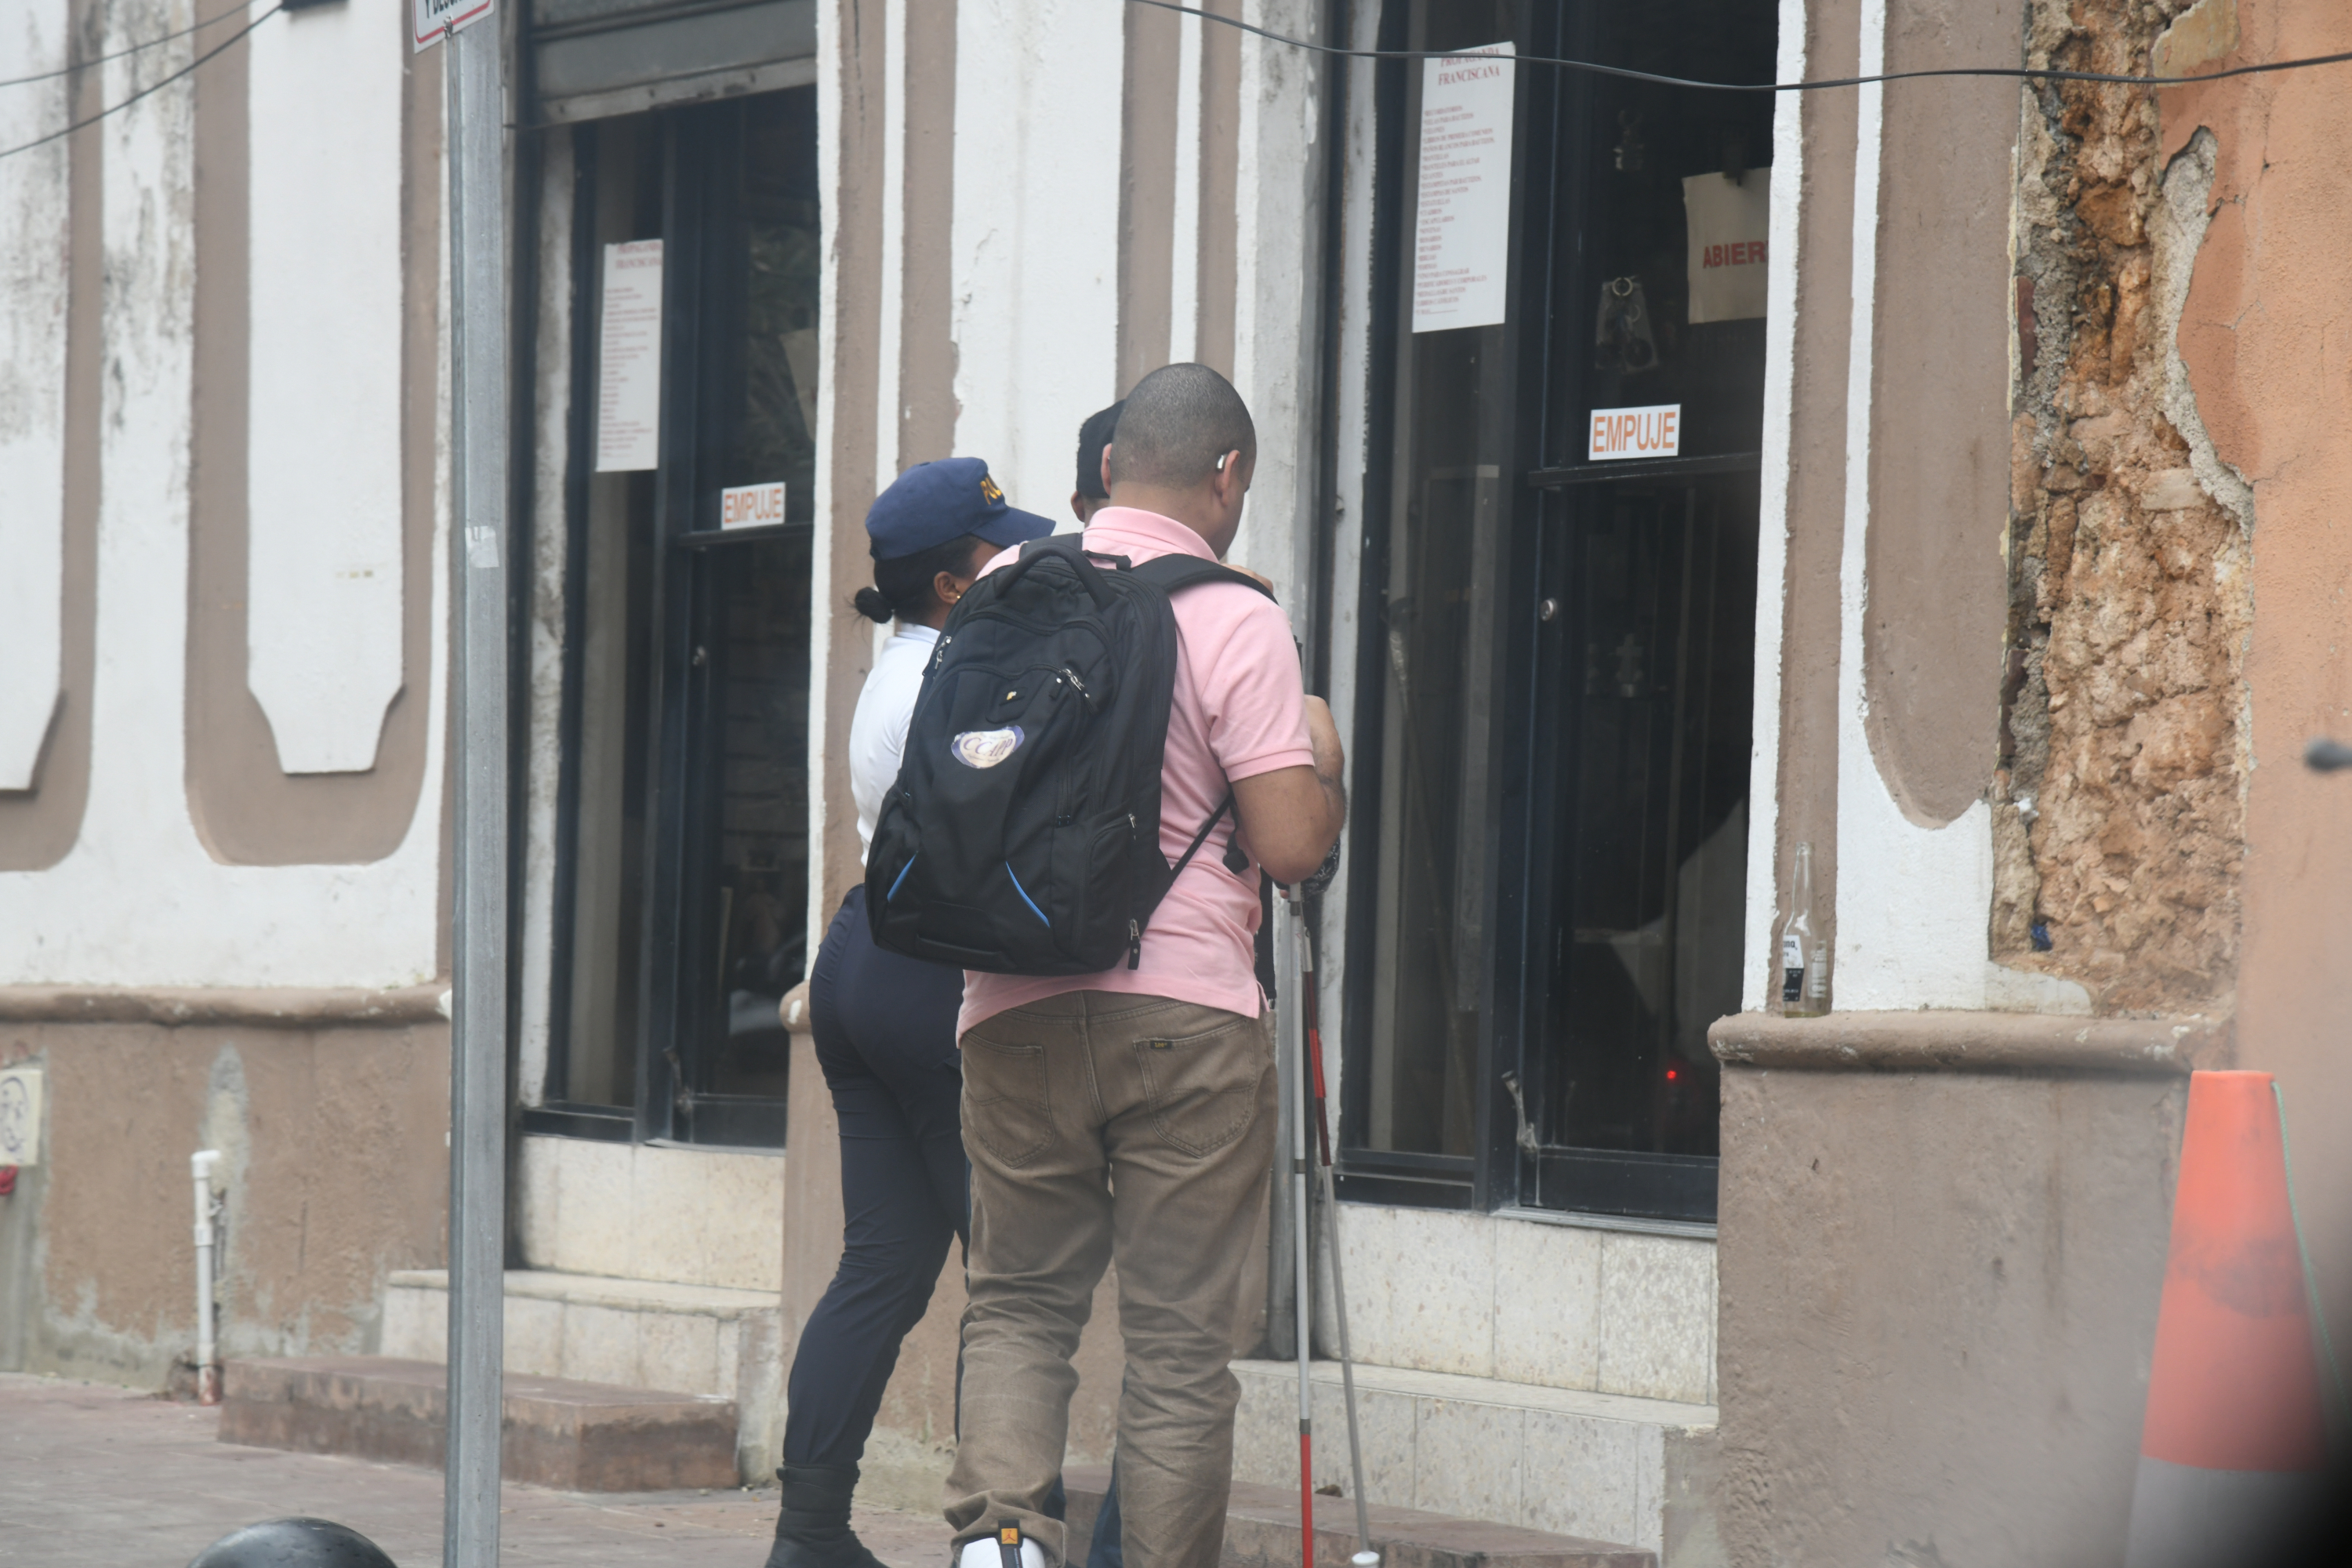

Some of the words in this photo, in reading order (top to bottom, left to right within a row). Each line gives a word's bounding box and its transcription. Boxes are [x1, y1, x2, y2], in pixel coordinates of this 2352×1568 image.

[1439, 66, 1500, 85] FRANCISCANA
[1703, 241, 1769, 268] ABIER
[1593, 412, 1676, 452] EMPUJE
[724, 488, 782, 524] EMPUJE
